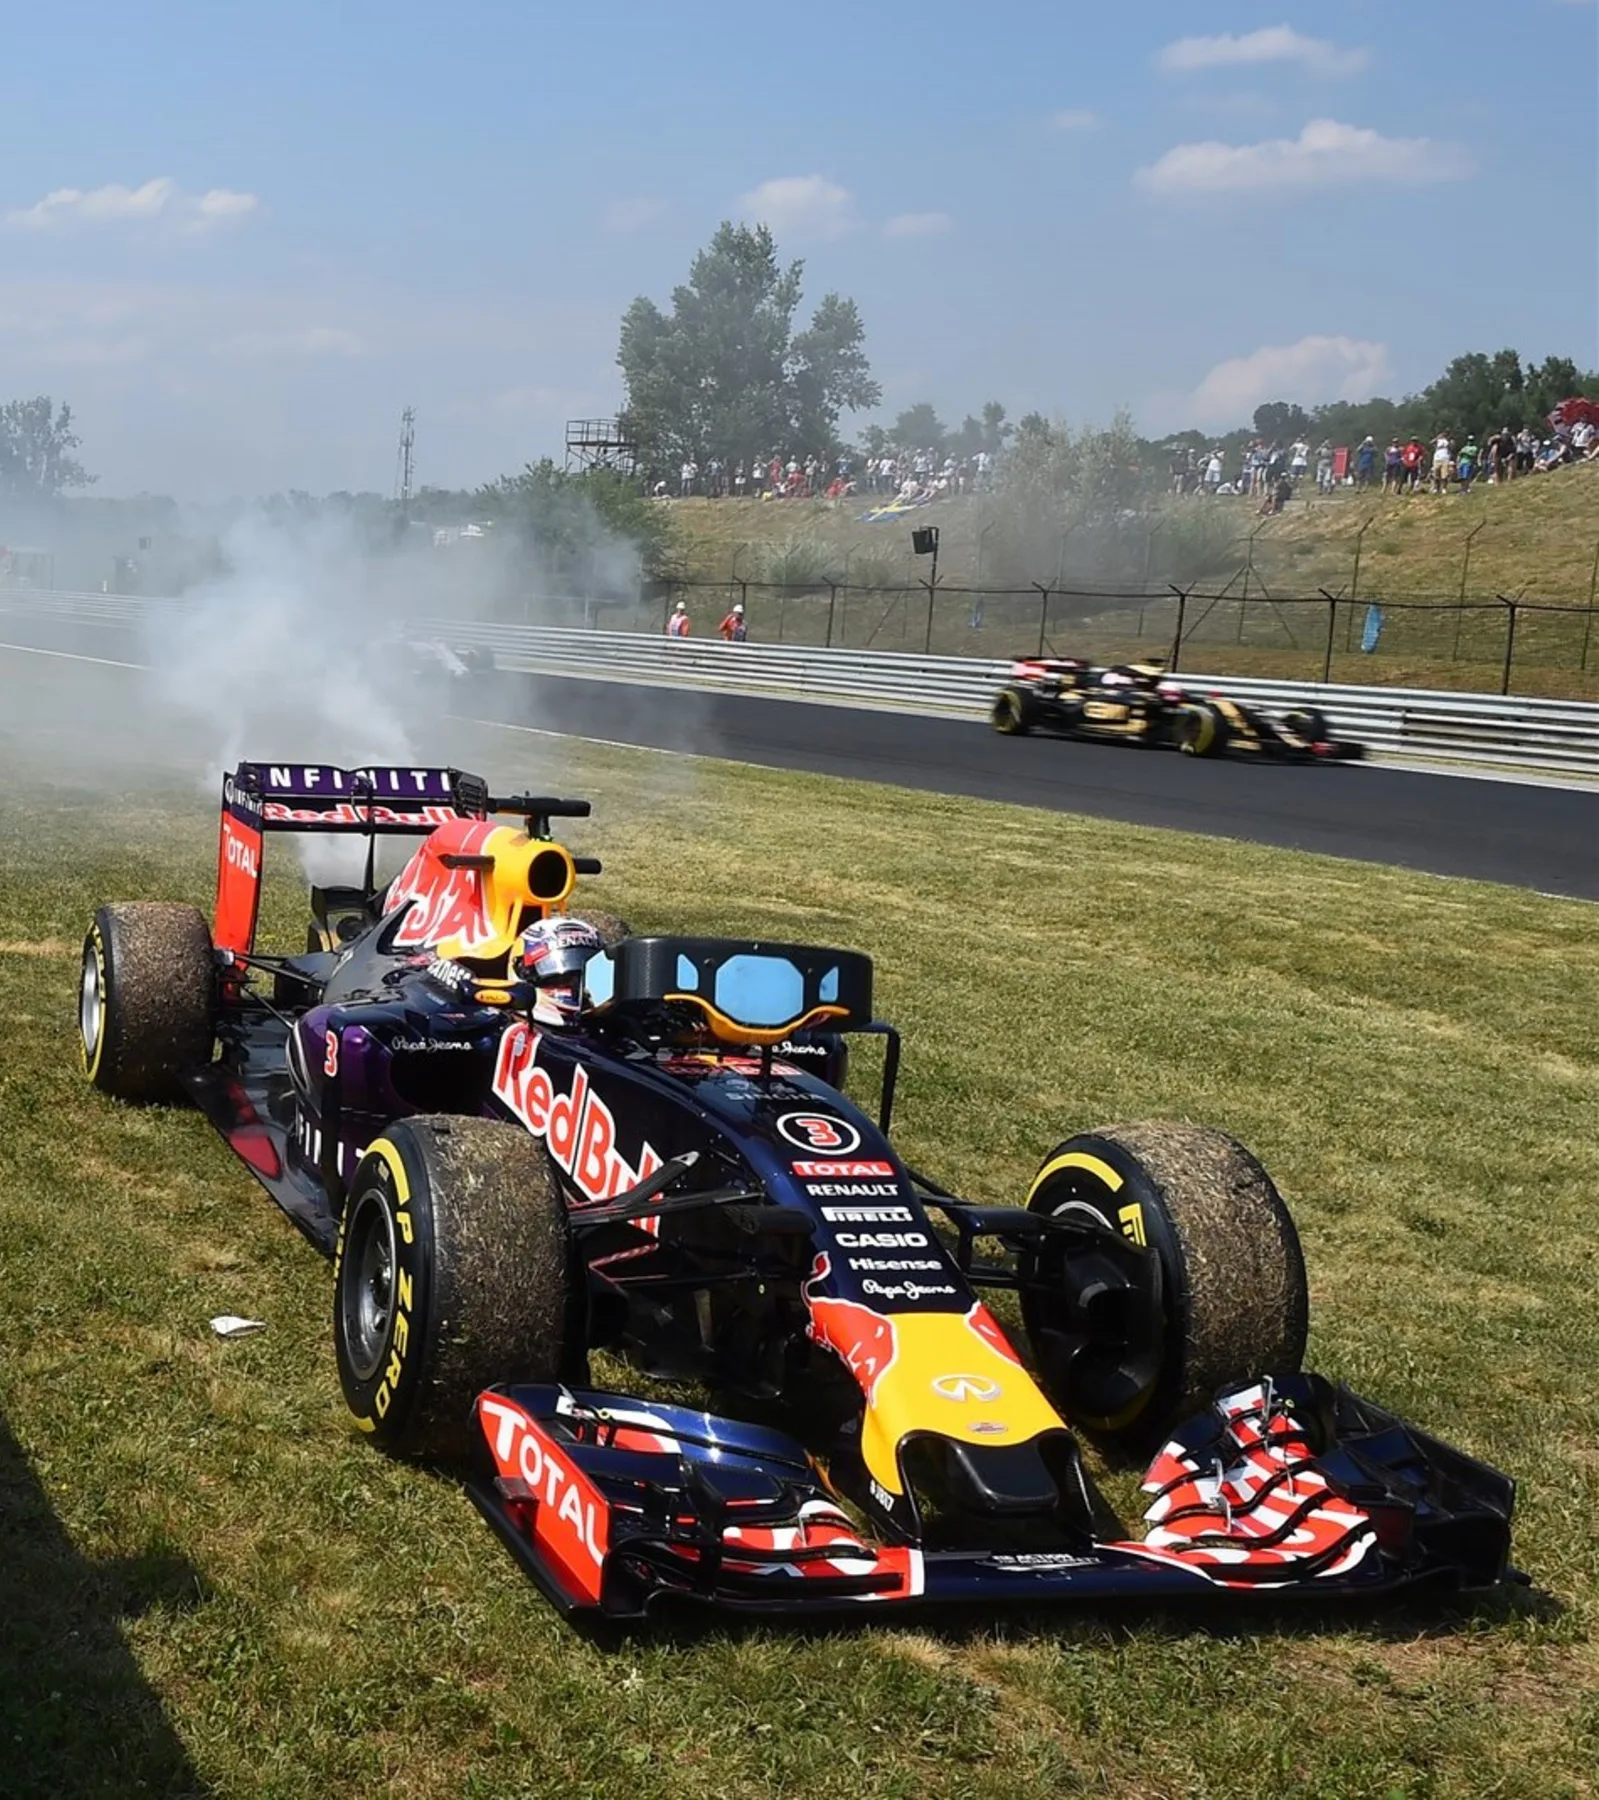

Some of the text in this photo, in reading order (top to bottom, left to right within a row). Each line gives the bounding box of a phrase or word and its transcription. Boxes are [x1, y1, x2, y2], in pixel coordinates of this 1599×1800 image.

[323, 1030, 339, 1078] 3
[795, 1118, 843, 1147] 3
[792, 1160, 895, 1177] TOTAL
[806, 1183, 899, 1197] RENAULT
[820, 1206, 914, 1222] PIRELLI
[835, 1233, 929, 1248] CASIO
[848, 1258, 943, 1271] Hisense
[374, 1211, 414, 1419] P ZERO
[482, 1398, 605, 1568] TOTAL
